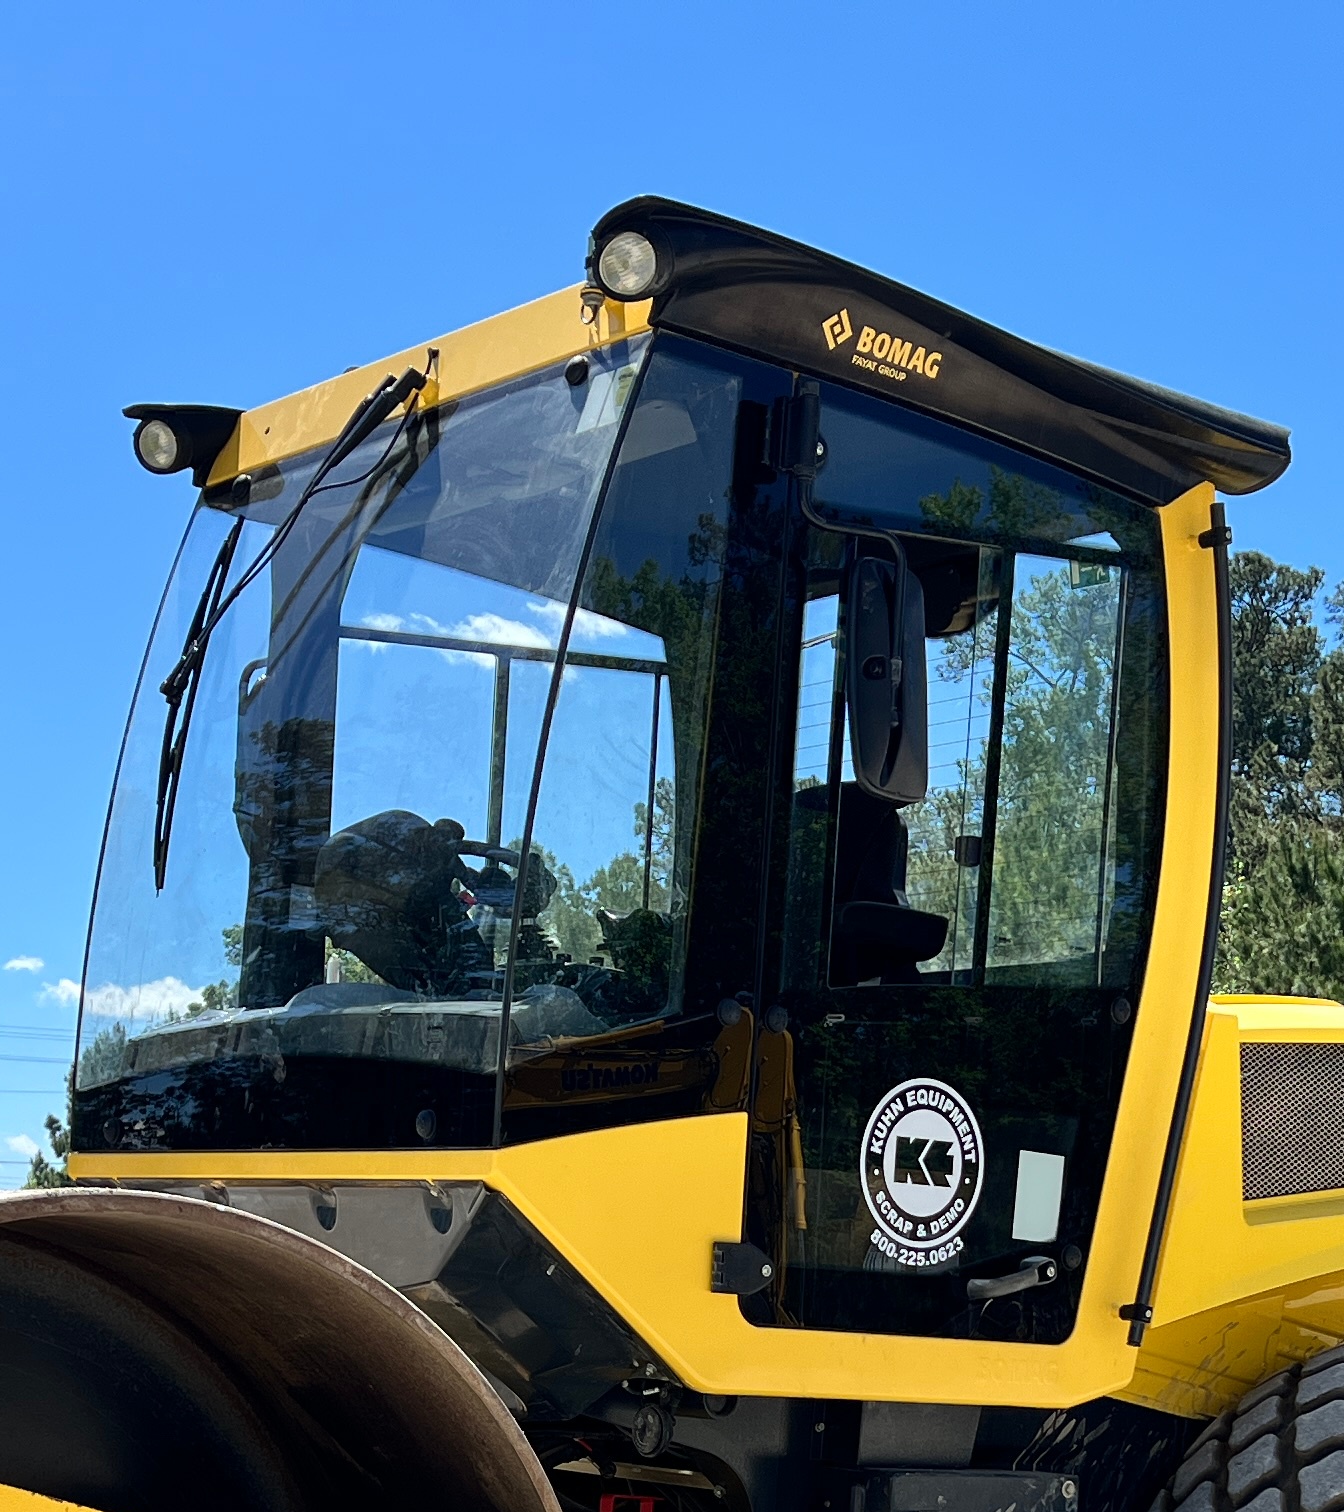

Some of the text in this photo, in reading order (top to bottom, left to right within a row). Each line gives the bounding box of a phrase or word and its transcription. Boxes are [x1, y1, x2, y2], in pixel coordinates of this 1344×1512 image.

[851, 354, 907, 381] FAYAT GROUP
[857, 325, 942, 379] BOMAG
[870, 1088, 976, 1163] KUHN EQUIPMENT
[876, 1190, 965, 1238] SCRAP & DEMO
[870, 1228, 964, 1267] 800.225.0623
